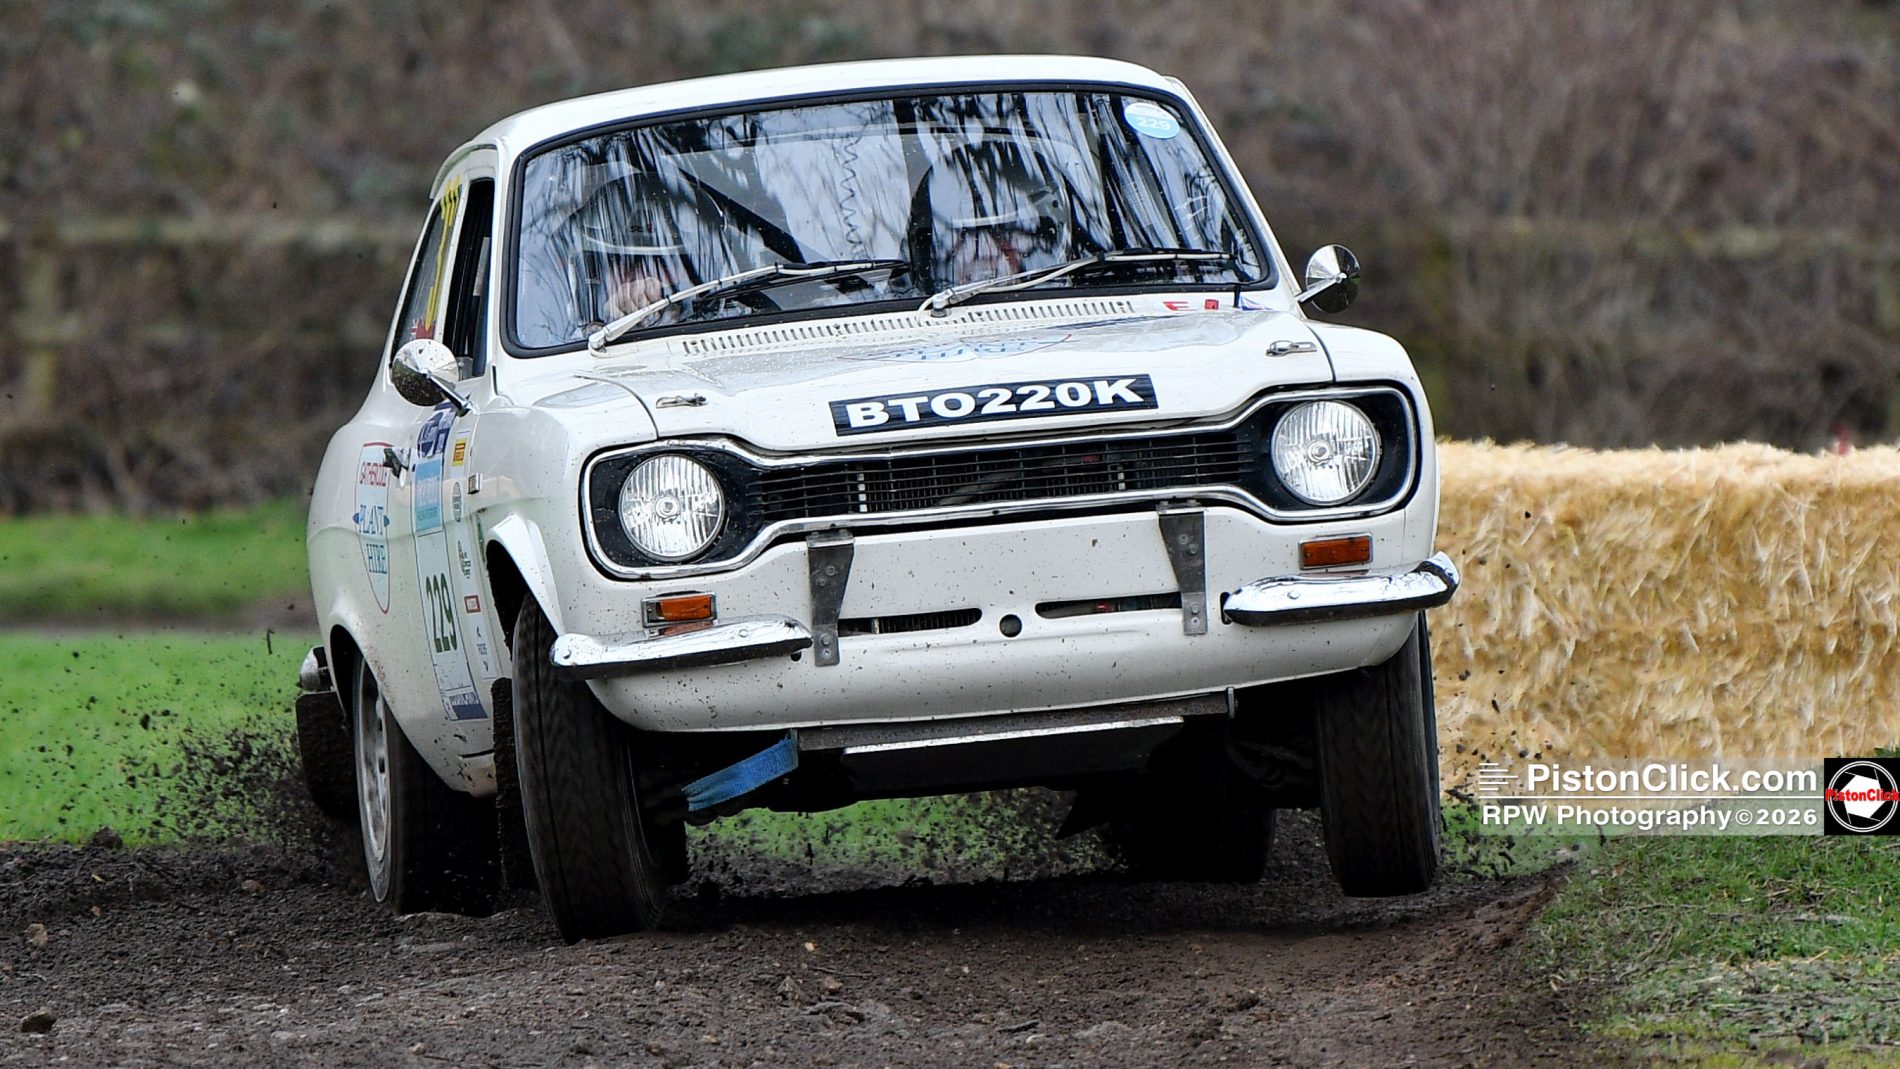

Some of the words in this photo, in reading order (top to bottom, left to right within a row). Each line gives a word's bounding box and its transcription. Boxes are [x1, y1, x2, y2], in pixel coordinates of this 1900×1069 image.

[1137, 116, 1171, 130] 229
[845, 378, 1146, 429] BTO220K
[359, 504, 384, 535] PLANT
[366, 543, 388, 575] HIRE
[426, 573, 458, 653] 229
